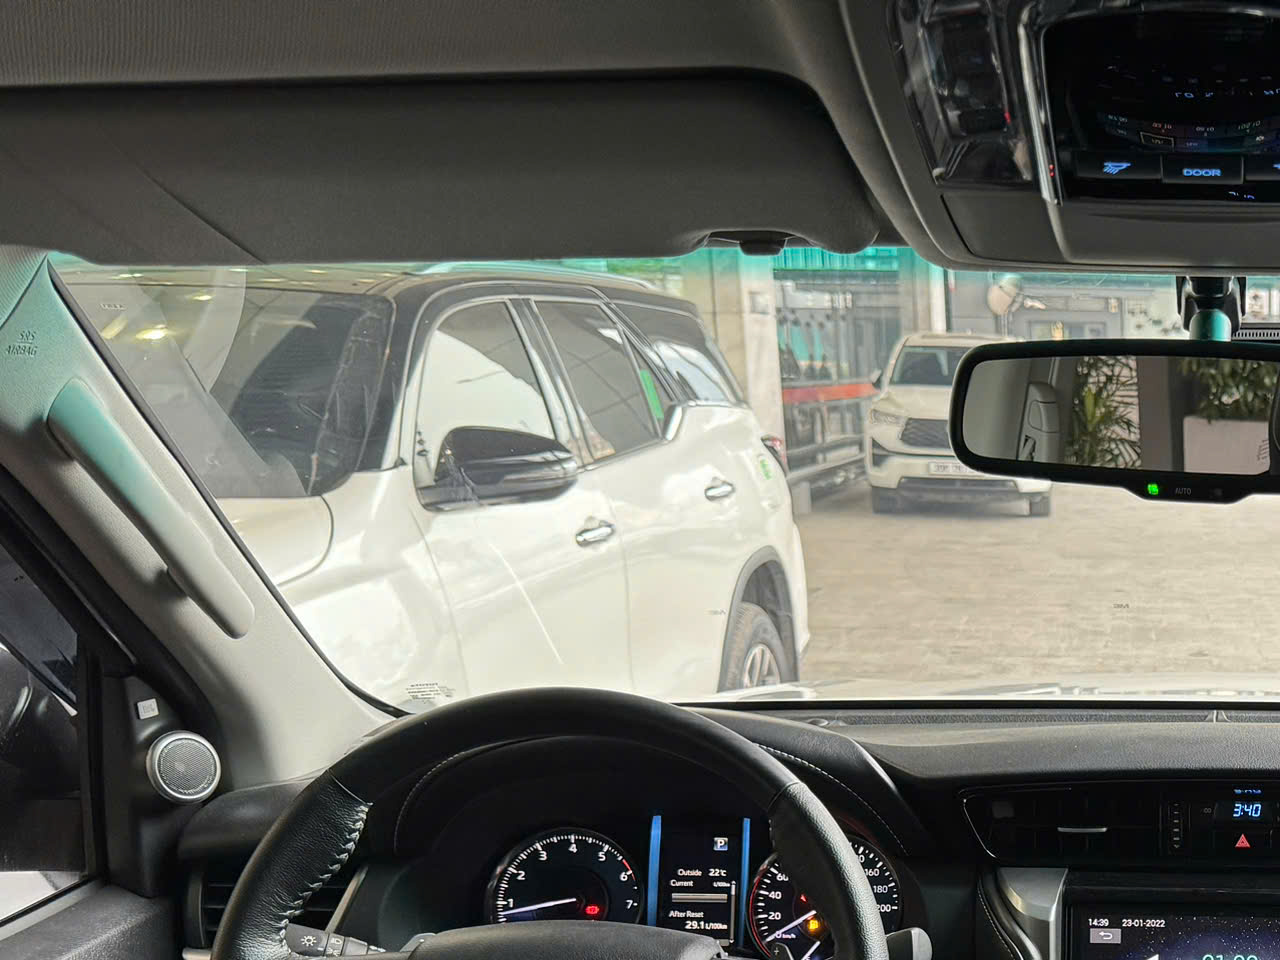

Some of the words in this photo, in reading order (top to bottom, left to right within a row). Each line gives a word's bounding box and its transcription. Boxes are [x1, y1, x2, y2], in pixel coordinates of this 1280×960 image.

[1183, 168, 1222, 177] DOOR
[19, 330, 36, 341] SRS
[6, 345, 38, 357] AIRBAG
[1233, 803, 1262, 817] 3:40
[568, 843, 578, 853] 4
[539, 850, 548, 861] 3
[598, 851, 606, 861] 5
[516, 870, 526, 880] 2
[619, 871, 629, 881] 6
[677, 868, 702, 876] Outside
[865, 868, 880, 877] 160
[670, 879, 694, 887] Current
[873, 885, 889, 894] 180
[768, 891, 782, 900] 40
[668, 910, 686, 918] After
[686, 910, 704, 918] Reset
[768, 912, 782, 921] 20
[685, 920, 704, 930] 29.1
[1088, 918, 1109, 927] 14:39
[1122, 919, 1166, 928] 23-01-2022
